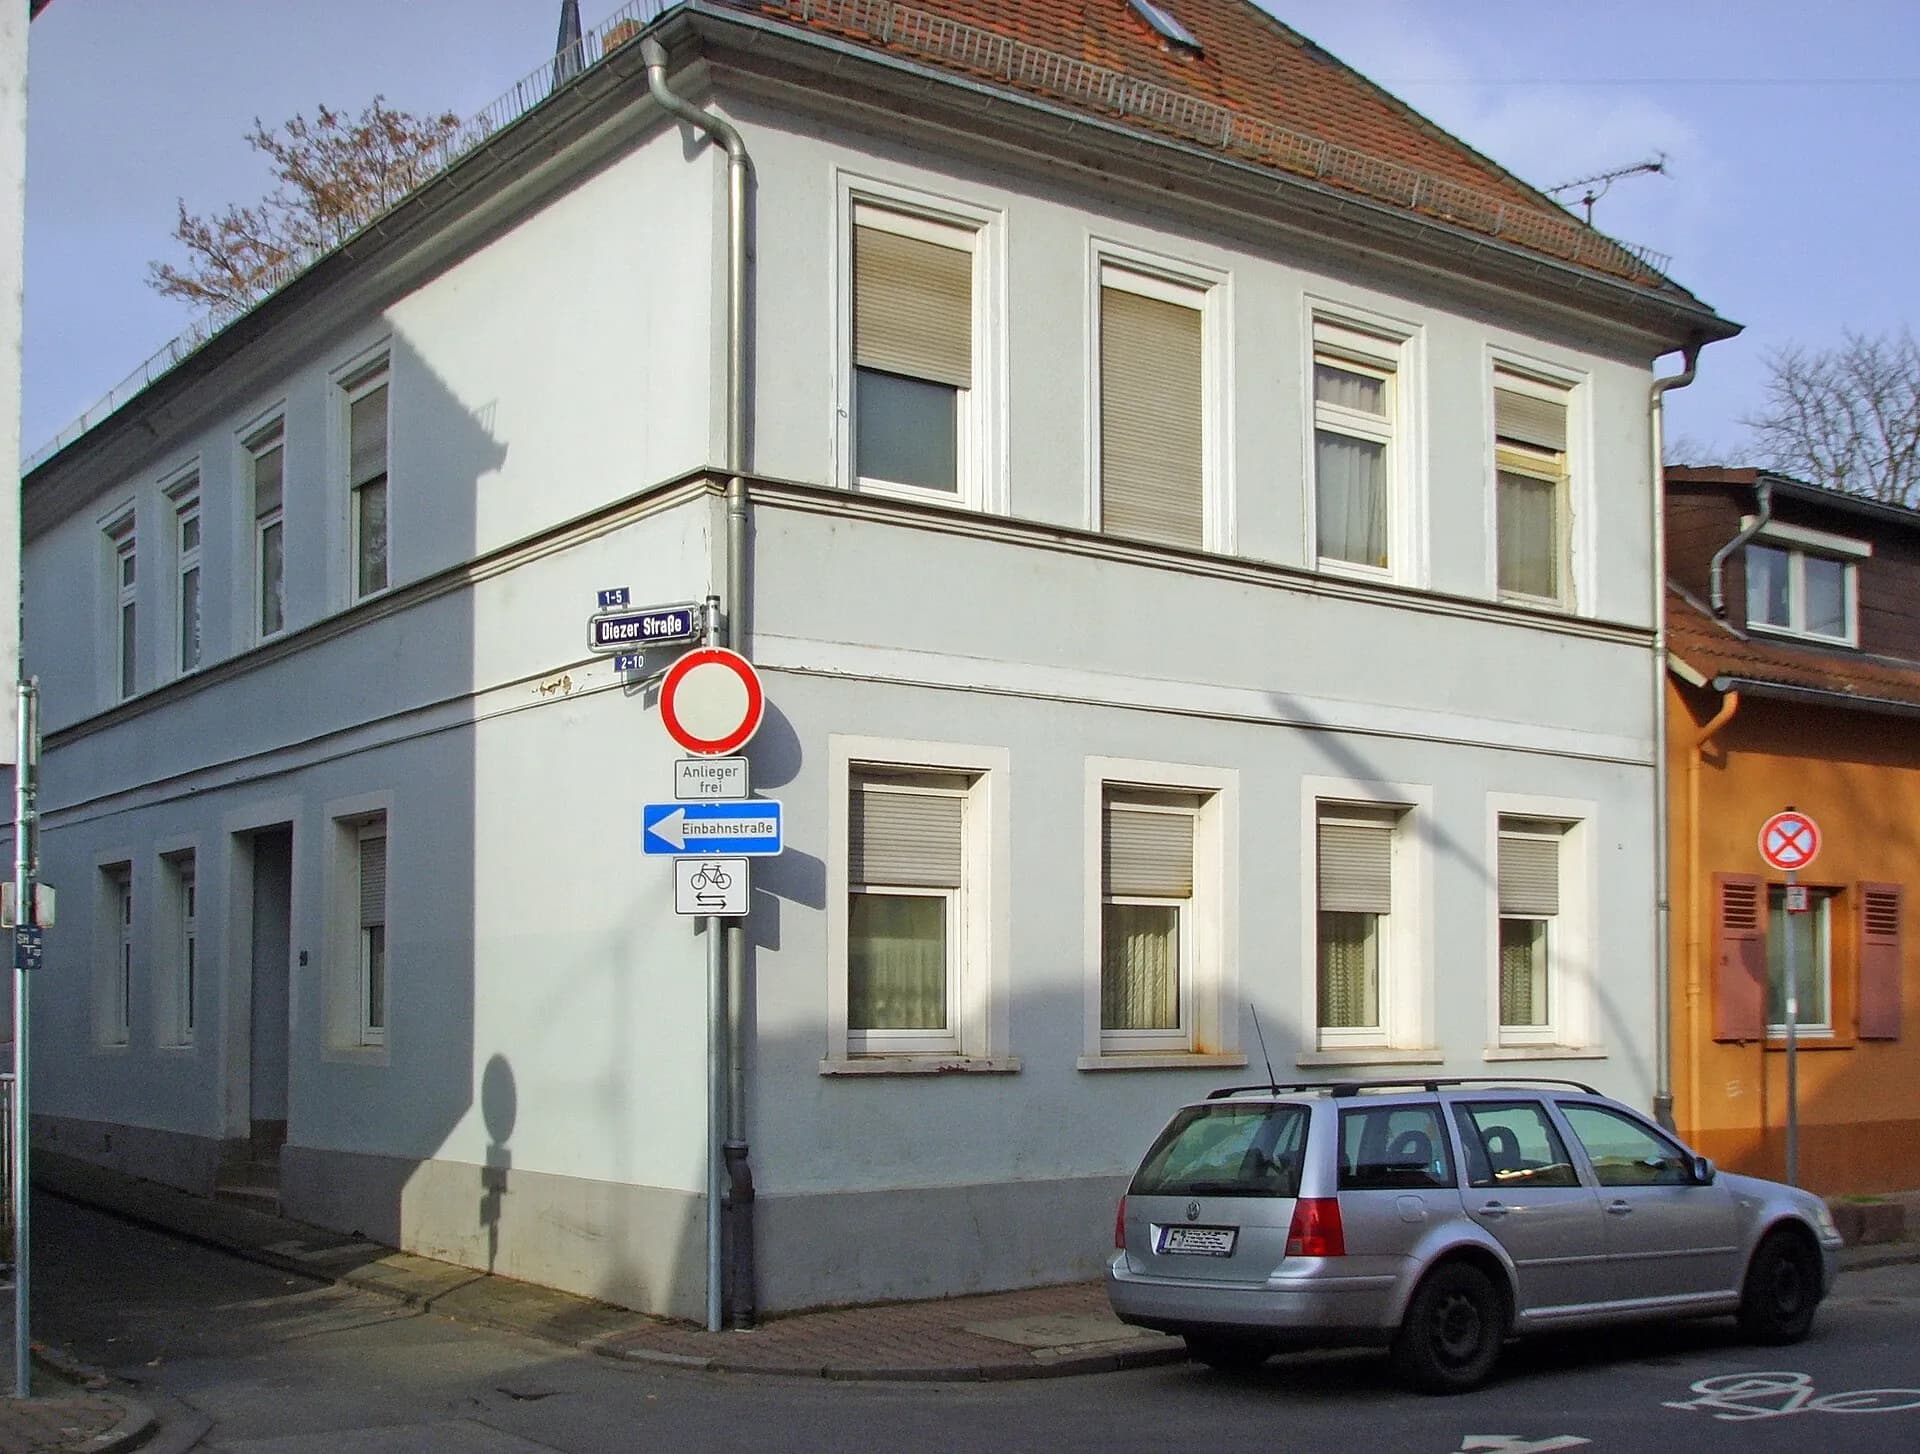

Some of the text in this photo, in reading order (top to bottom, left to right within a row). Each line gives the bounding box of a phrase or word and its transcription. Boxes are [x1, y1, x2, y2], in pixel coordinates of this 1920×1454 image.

[605, 590, 622, 604] 1-5
[602, 615, 682, 640] Diezer Straße
[621, 655, 644, 670] 2-10
[683, 766, 738, 780] Anlieger
[700, 781, 722, 793] frei
[682, 822, 773, 835] Einbahnstraße
